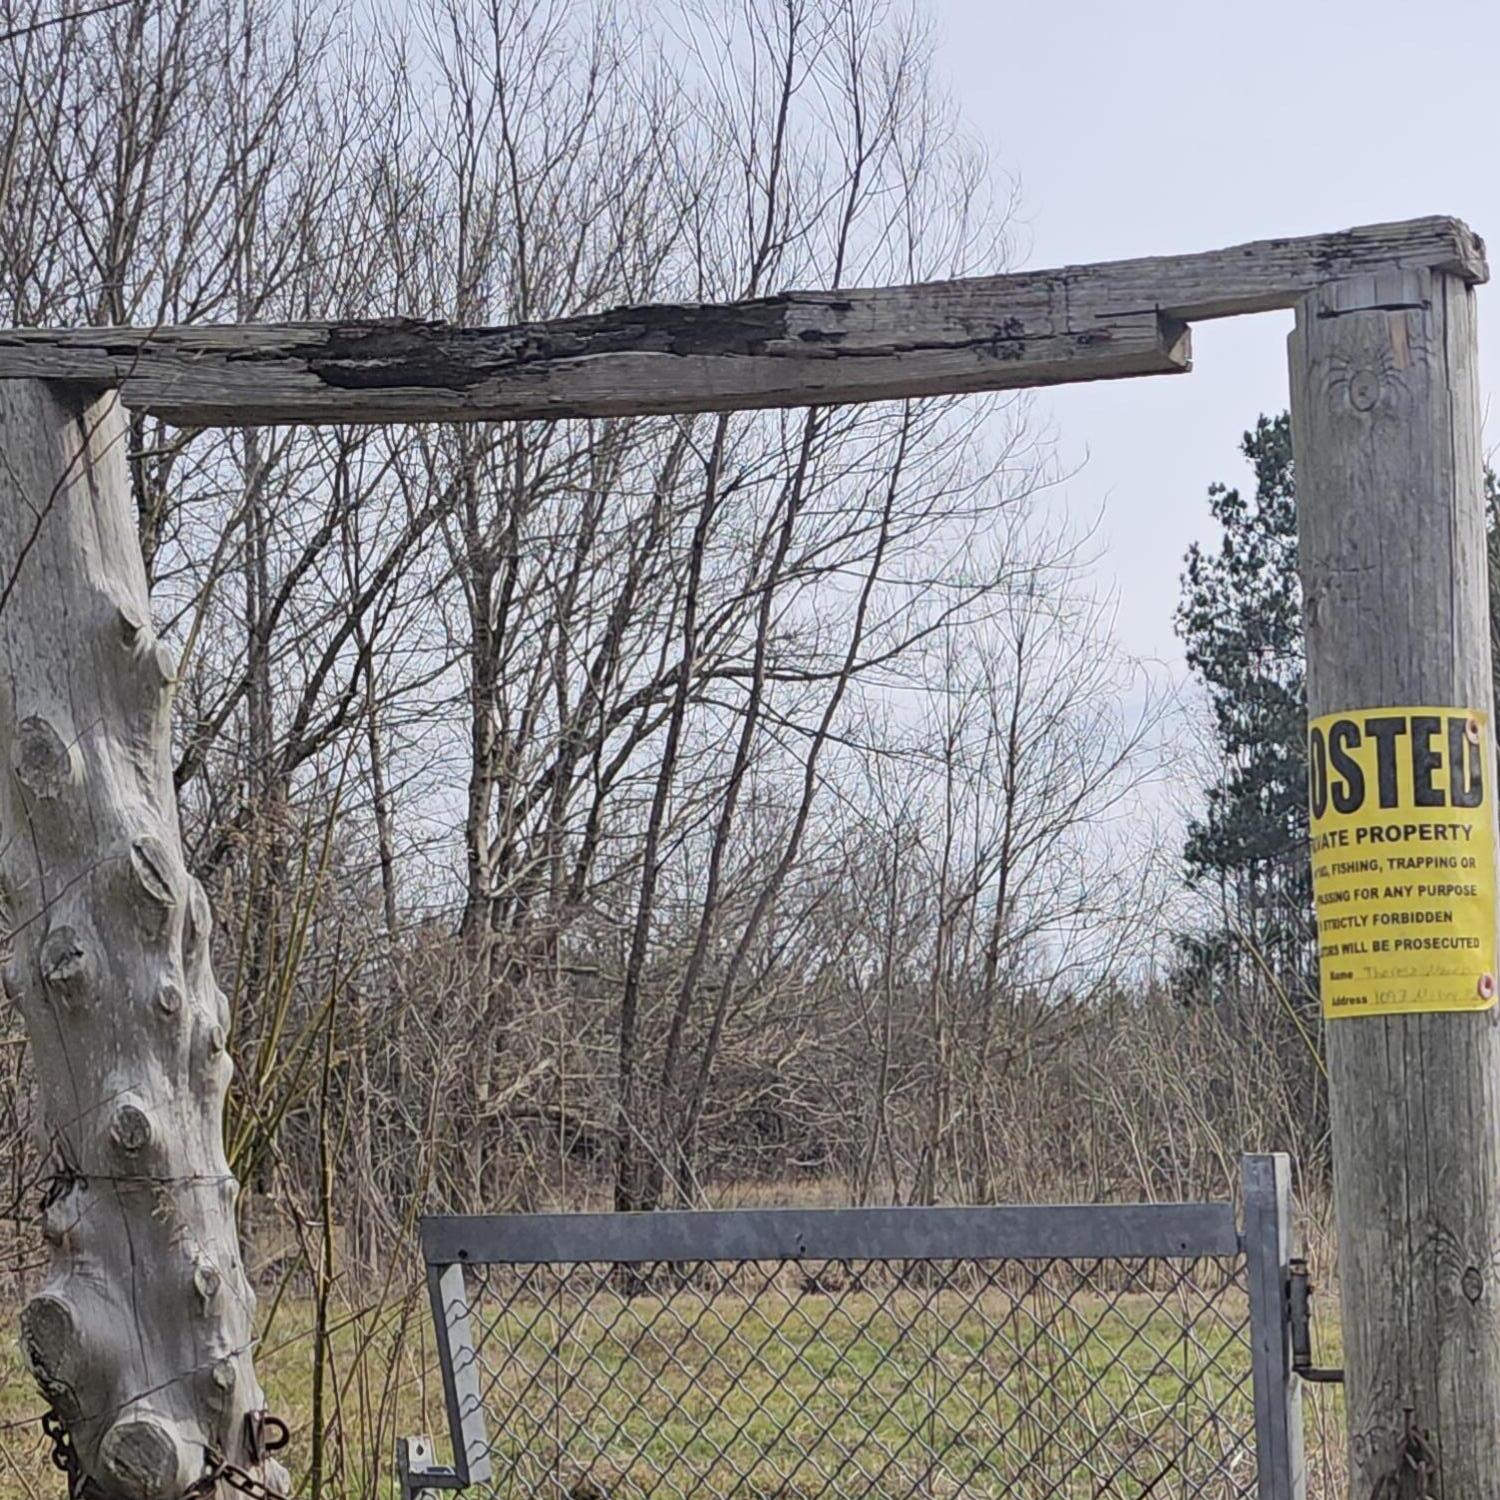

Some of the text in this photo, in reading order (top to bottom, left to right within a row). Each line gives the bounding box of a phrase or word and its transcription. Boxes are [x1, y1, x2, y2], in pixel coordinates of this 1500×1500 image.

[1356, 823, 1474, 845] PROPERTY
[1331, 859, 1383, 876] FISHING,
[1387, 856, 1458, 870] TRAPPING
[1461, 856, 1477, 869] OR
[1353, 887, 1379, 901] FOR
[1384, 885, 1414, 899] ANY
[1418, 884, 1478, 897] PURPOSE
[1372, 911, 1453, 926] FORBIDDEN
[1342, 941, 1368, 955] WILL
[1372, 940, 1390, 952] BE
[1394, 937, 1480, 951] PROSECUTED
